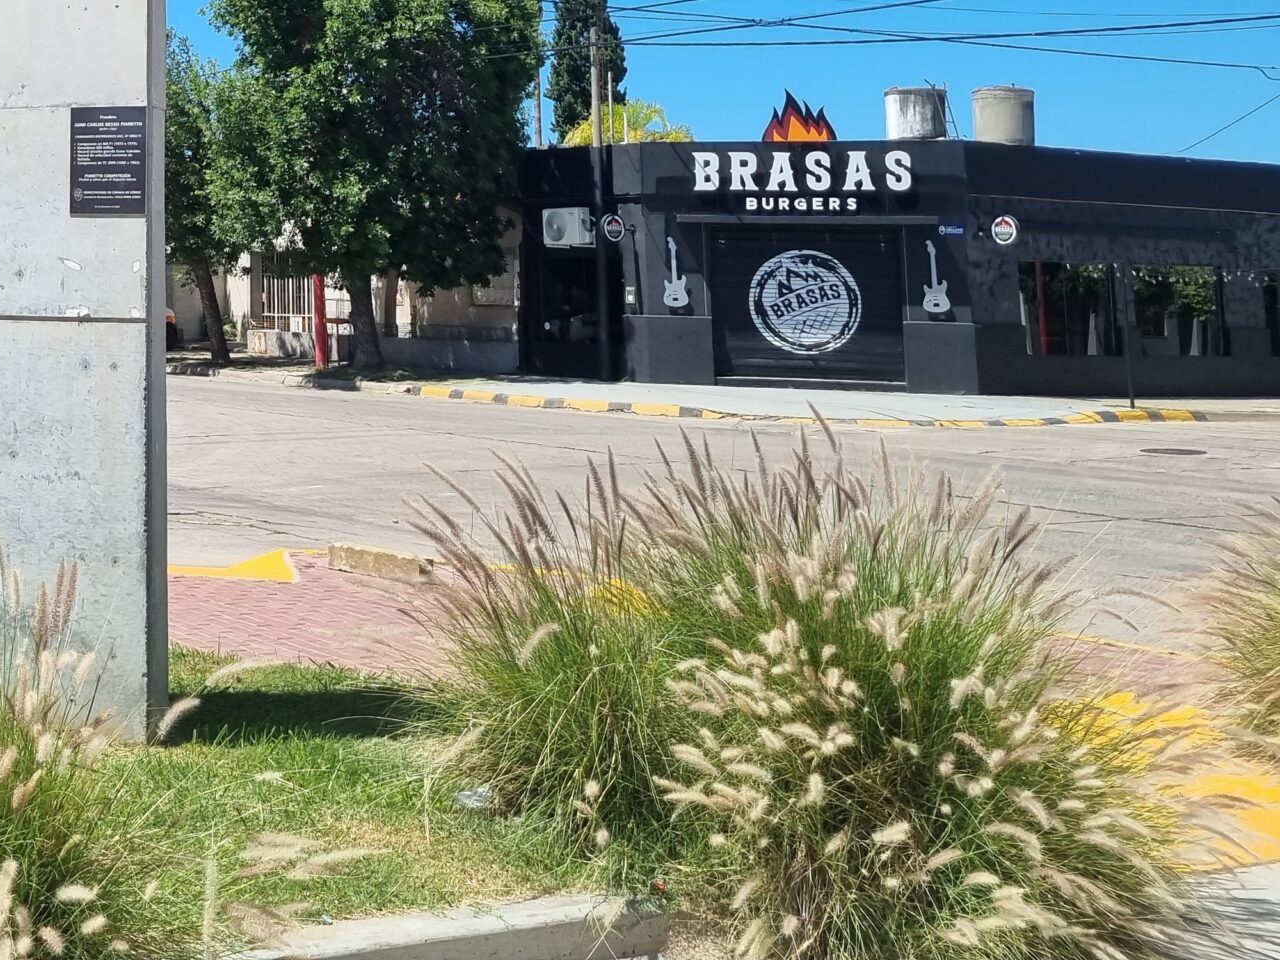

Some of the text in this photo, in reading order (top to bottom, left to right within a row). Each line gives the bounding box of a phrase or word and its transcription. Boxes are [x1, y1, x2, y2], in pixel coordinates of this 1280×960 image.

[692, 150, 912, 191] BRASAS
[745, 197, 858, 211] BURGERS
[768, 283, 841, 319] BRASAS
